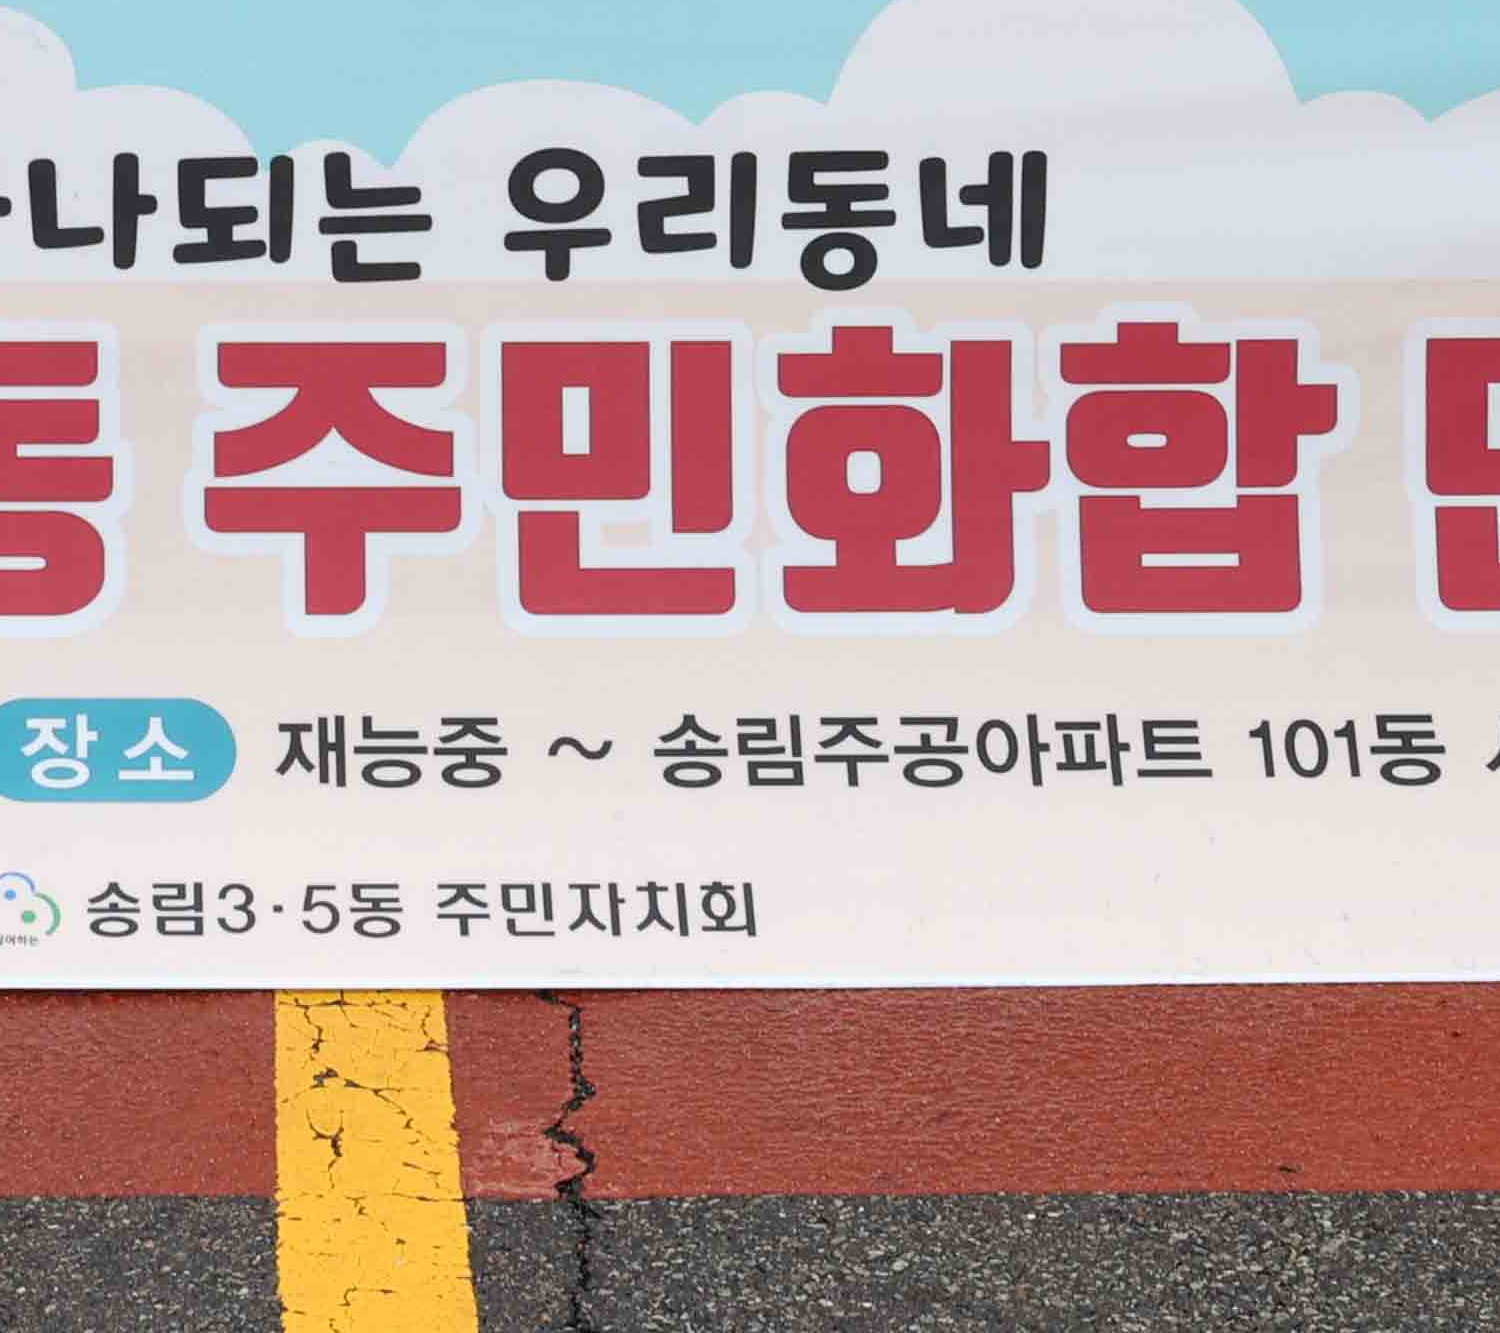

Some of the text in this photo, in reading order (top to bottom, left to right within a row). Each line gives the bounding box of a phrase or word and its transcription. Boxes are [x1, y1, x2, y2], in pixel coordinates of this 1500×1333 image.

[503, 146, 1047, 292] 우리동네
[204, 321, 1338, 615] 주민화합
[276, 714, 508, 789] 재능중
[653, 713, 1213, 789] 송림주공아파트
[1249, 714, 1446, 787] 101동
[86, 881, 402, 939] 송림3·5동
[437, 881, 756, 938] 주민자치회
